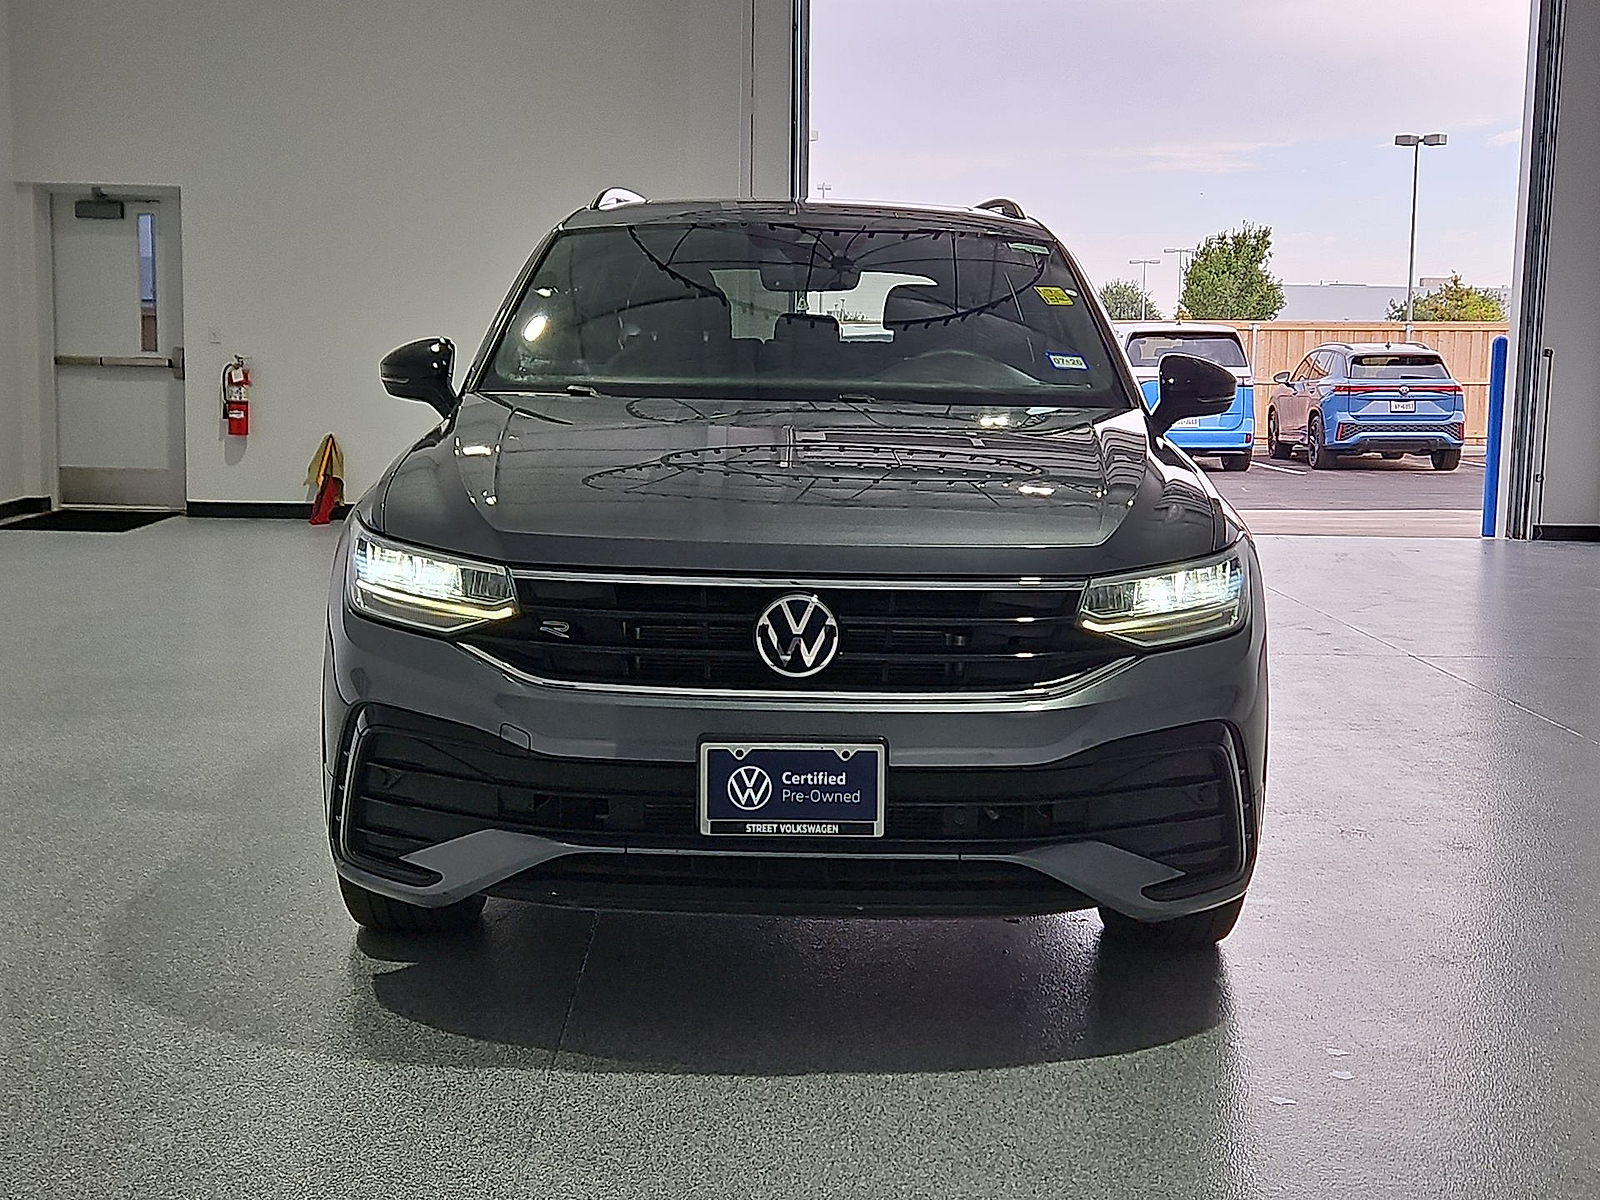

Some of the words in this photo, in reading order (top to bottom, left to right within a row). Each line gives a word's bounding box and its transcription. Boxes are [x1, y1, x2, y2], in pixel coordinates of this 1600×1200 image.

[781, 771, 847, 786] Certified
[729, 767, 771, 808] VW
[782, 789, 861, 804] Pre-Owned
[745, 823, 778, 833] STREET
[779, 824, 839, 834] VOLKSWAGEN
